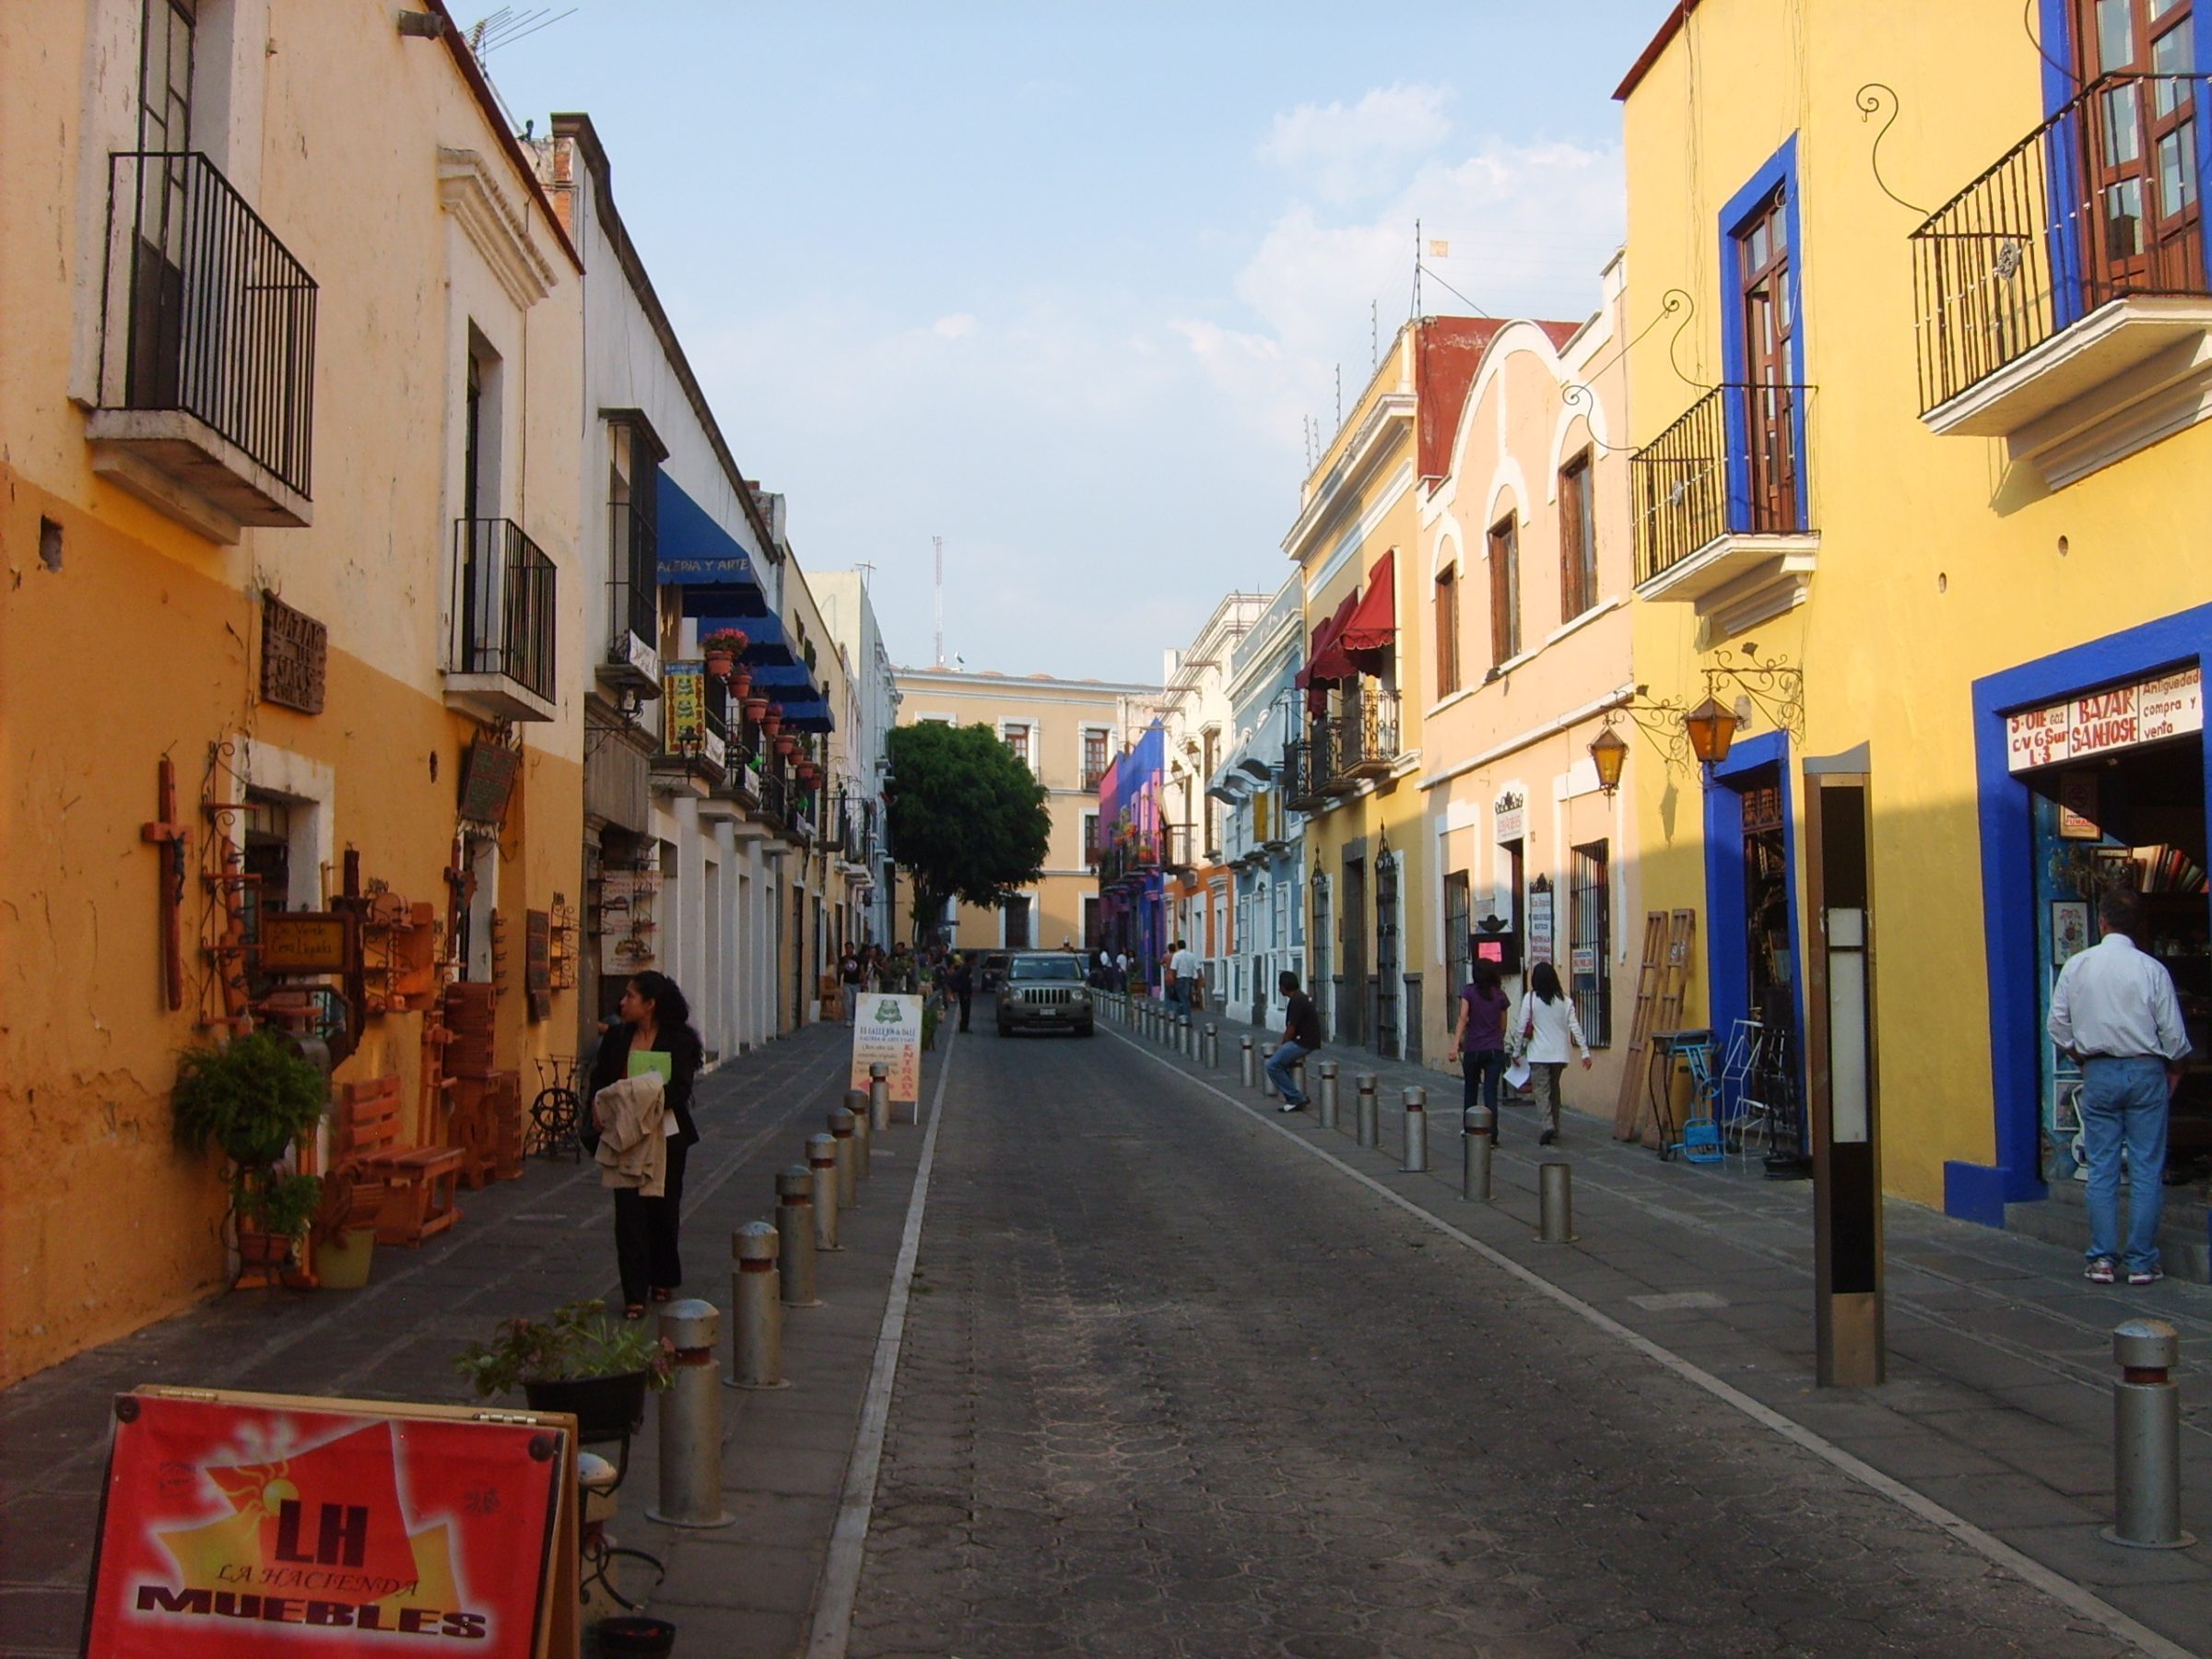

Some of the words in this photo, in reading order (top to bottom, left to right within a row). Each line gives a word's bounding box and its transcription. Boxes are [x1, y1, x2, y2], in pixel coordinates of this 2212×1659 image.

[704, 556, 713, 571] Y
[719, 555, 749, 571] ARTE
[2078, 688, 2136, 724] BAZAR
[2143, 700, 2182, 718] compra
[2045, 727, 2069, 745] Sur
[2144, 720, 2173, 739] venta
[276, 1499, 369, 1568] LH
[217, 1564, 253, 1583] LA
[259, 1566, 419, 1597] HACIENDA
[136, 1584, 487, 1640] MUEBLES
